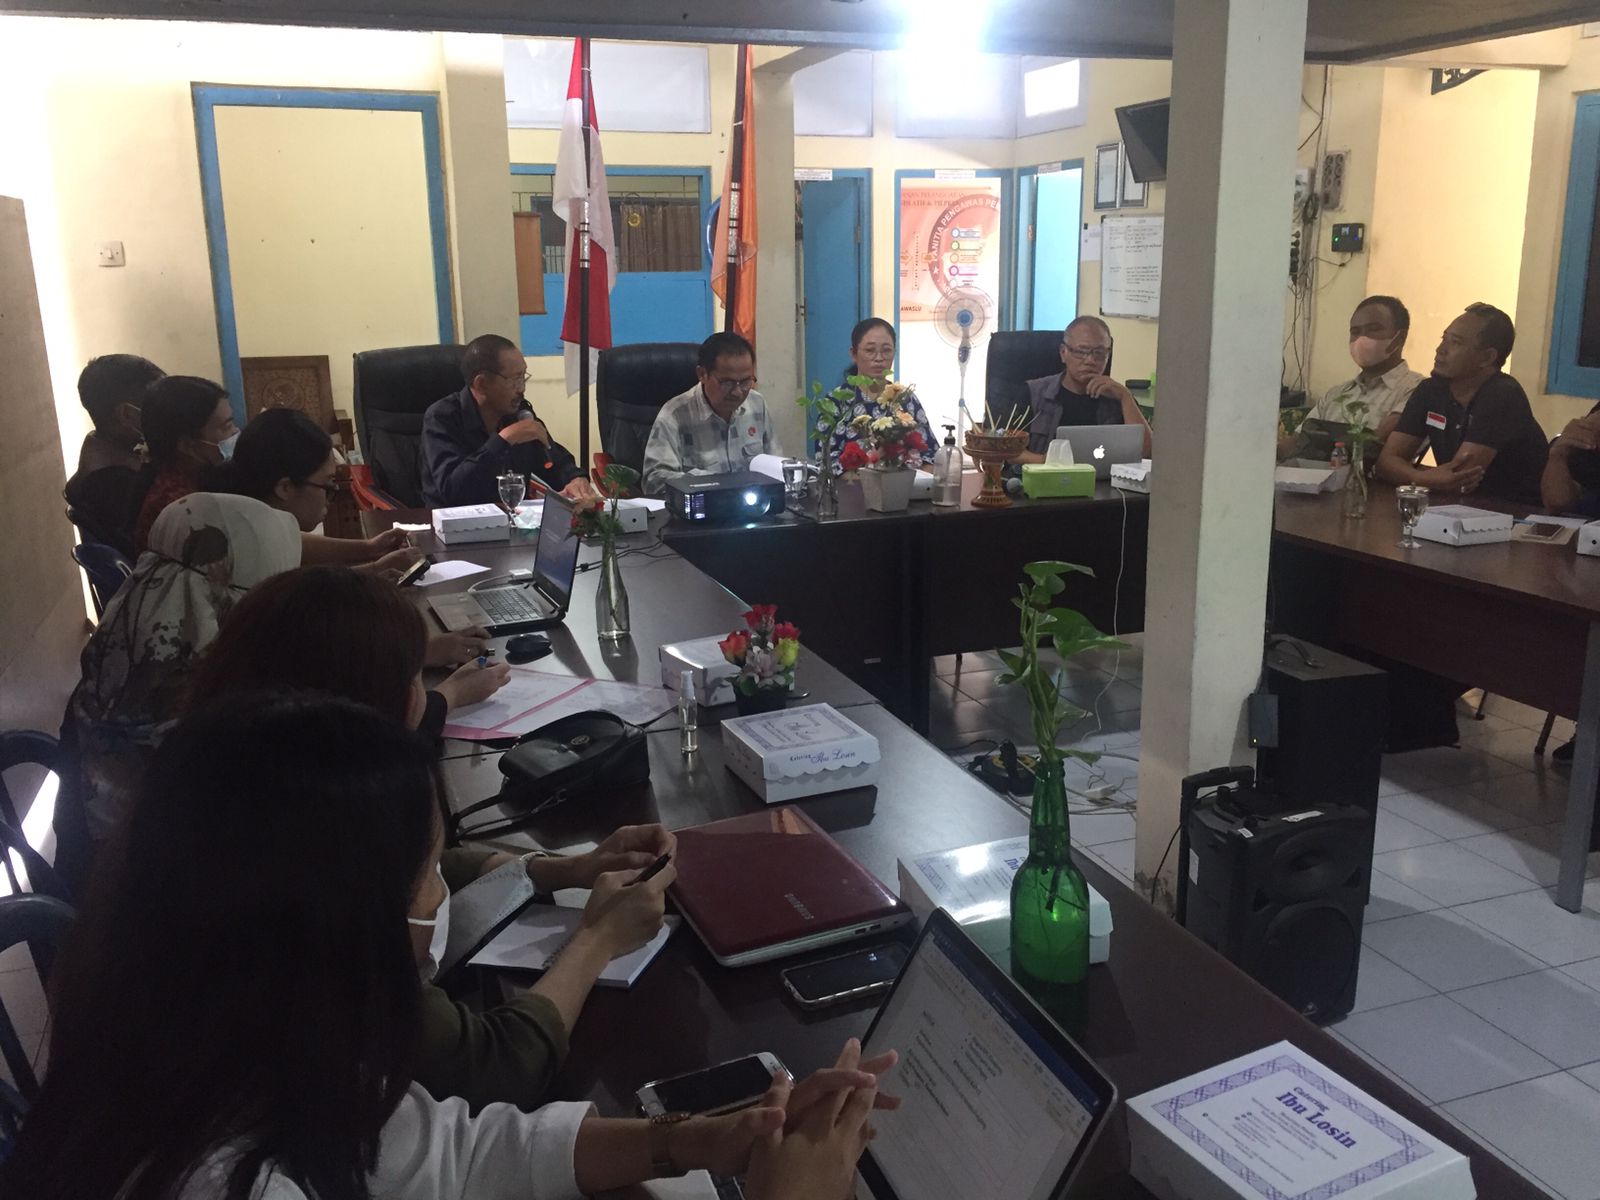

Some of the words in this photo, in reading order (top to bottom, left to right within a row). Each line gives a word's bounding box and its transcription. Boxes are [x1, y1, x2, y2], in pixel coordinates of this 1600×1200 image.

[941, 198, 984, 226] PENGAWAS
[1293, 1086, 1330, 1112] Catering
[1275, 1091, 1307, 1114] Ibu
[1305, 1111, 1356, 1149] Losin
